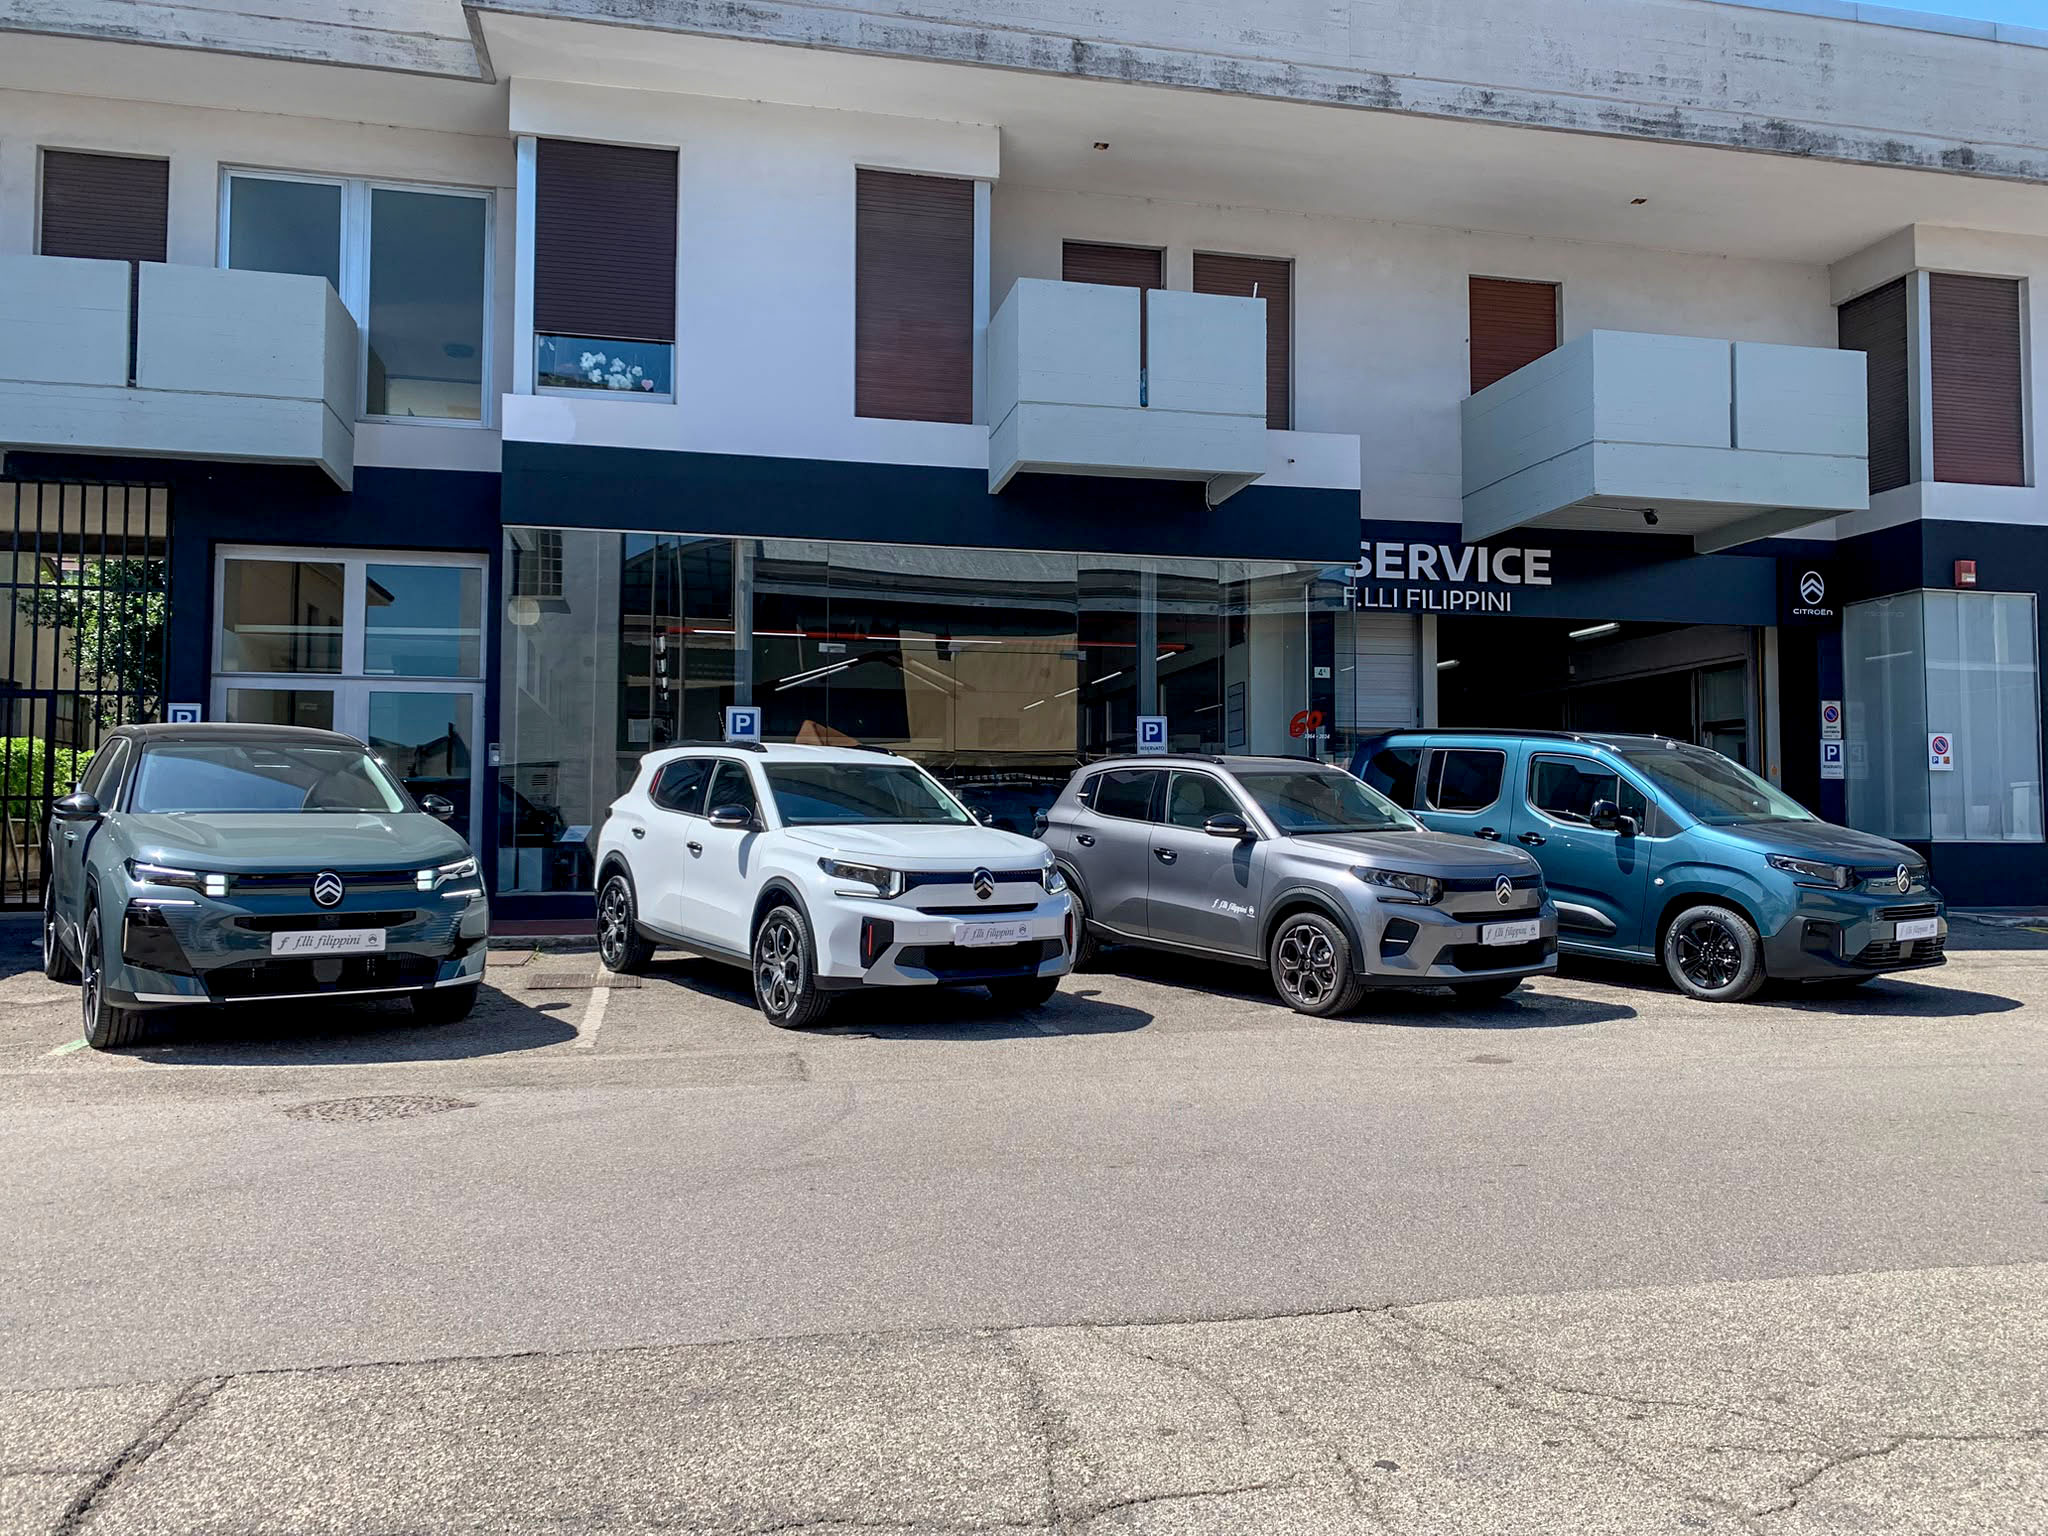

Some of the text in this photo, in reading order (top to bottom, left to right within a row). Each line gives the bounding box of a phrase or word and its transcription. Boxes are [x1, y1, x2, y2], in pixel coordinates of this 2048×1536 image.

[1345, 541, 1552, 586] SERVICE
[1343, 586, 1511, 612] F.LLI FILIPPINI
[735, 714, 751, 733] P
[1145, 723, 1159, 741] P
[1289, 709, 1323, 738] 60
[1827, 745, 1838, 761] P
[292, 935, 314, 950] f.lli
[314, 933, 361, 949] filippini
